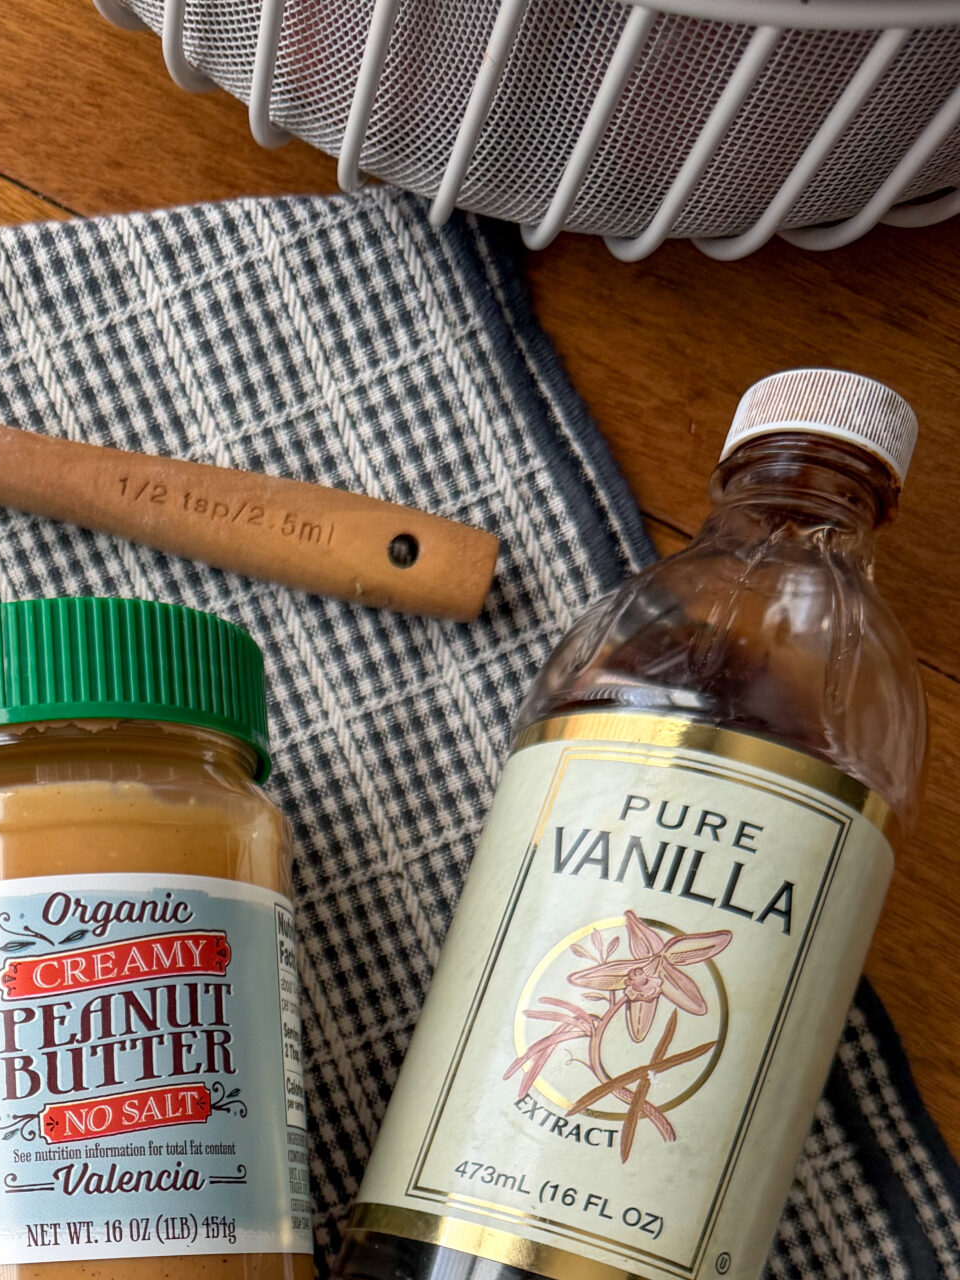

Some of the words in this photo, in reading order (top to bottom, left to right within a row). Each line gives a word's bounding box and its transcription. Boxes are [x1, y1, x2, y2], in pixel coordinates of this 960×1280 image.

[117, 476, 168, 504] 1/2
[619, 793, 764, 854] PURE
[553, 826, 795, 936] VANILLA
[42, 892, 194, 937] Organic
[32, 939, 208, 989] CREAMY
[0, 1029, 238, 1101] BUTTER
[64, 1106, 113, 1137] NO
[122, 1091, 199, 1126] SALT
[513, 1092, 619, 1148] EXTRACT
[13, 1149, 32, 1164] See
[35, 1146, 82, 1162] nutrition
[85, 1142, 147, 1159] information
[148, 1141, 163, 1156] for
[165, 1140, 188, 1156] total
[190, 1140, 203, 1155] fat
[204, 1141, 237, 1156] content
[52, 1161, 206, 1196] Valencia
[454, 1159, 531, 1195] 473mL
[538, 1180, 578, 1207] (16
[582, 1193, 613, 1220] FL
[621, 1207, 665, 1240] OZ)
[26, 1223, 61, 1247] NET
[67, 1220, 99, 1244] WT.
[104, 1219, 123, 1243] 16
[129, 1218, 151, 1241] OZ
[156, 1213, 198, 1244] (1LB)
[201, 1215, 237, 1244] 454g
